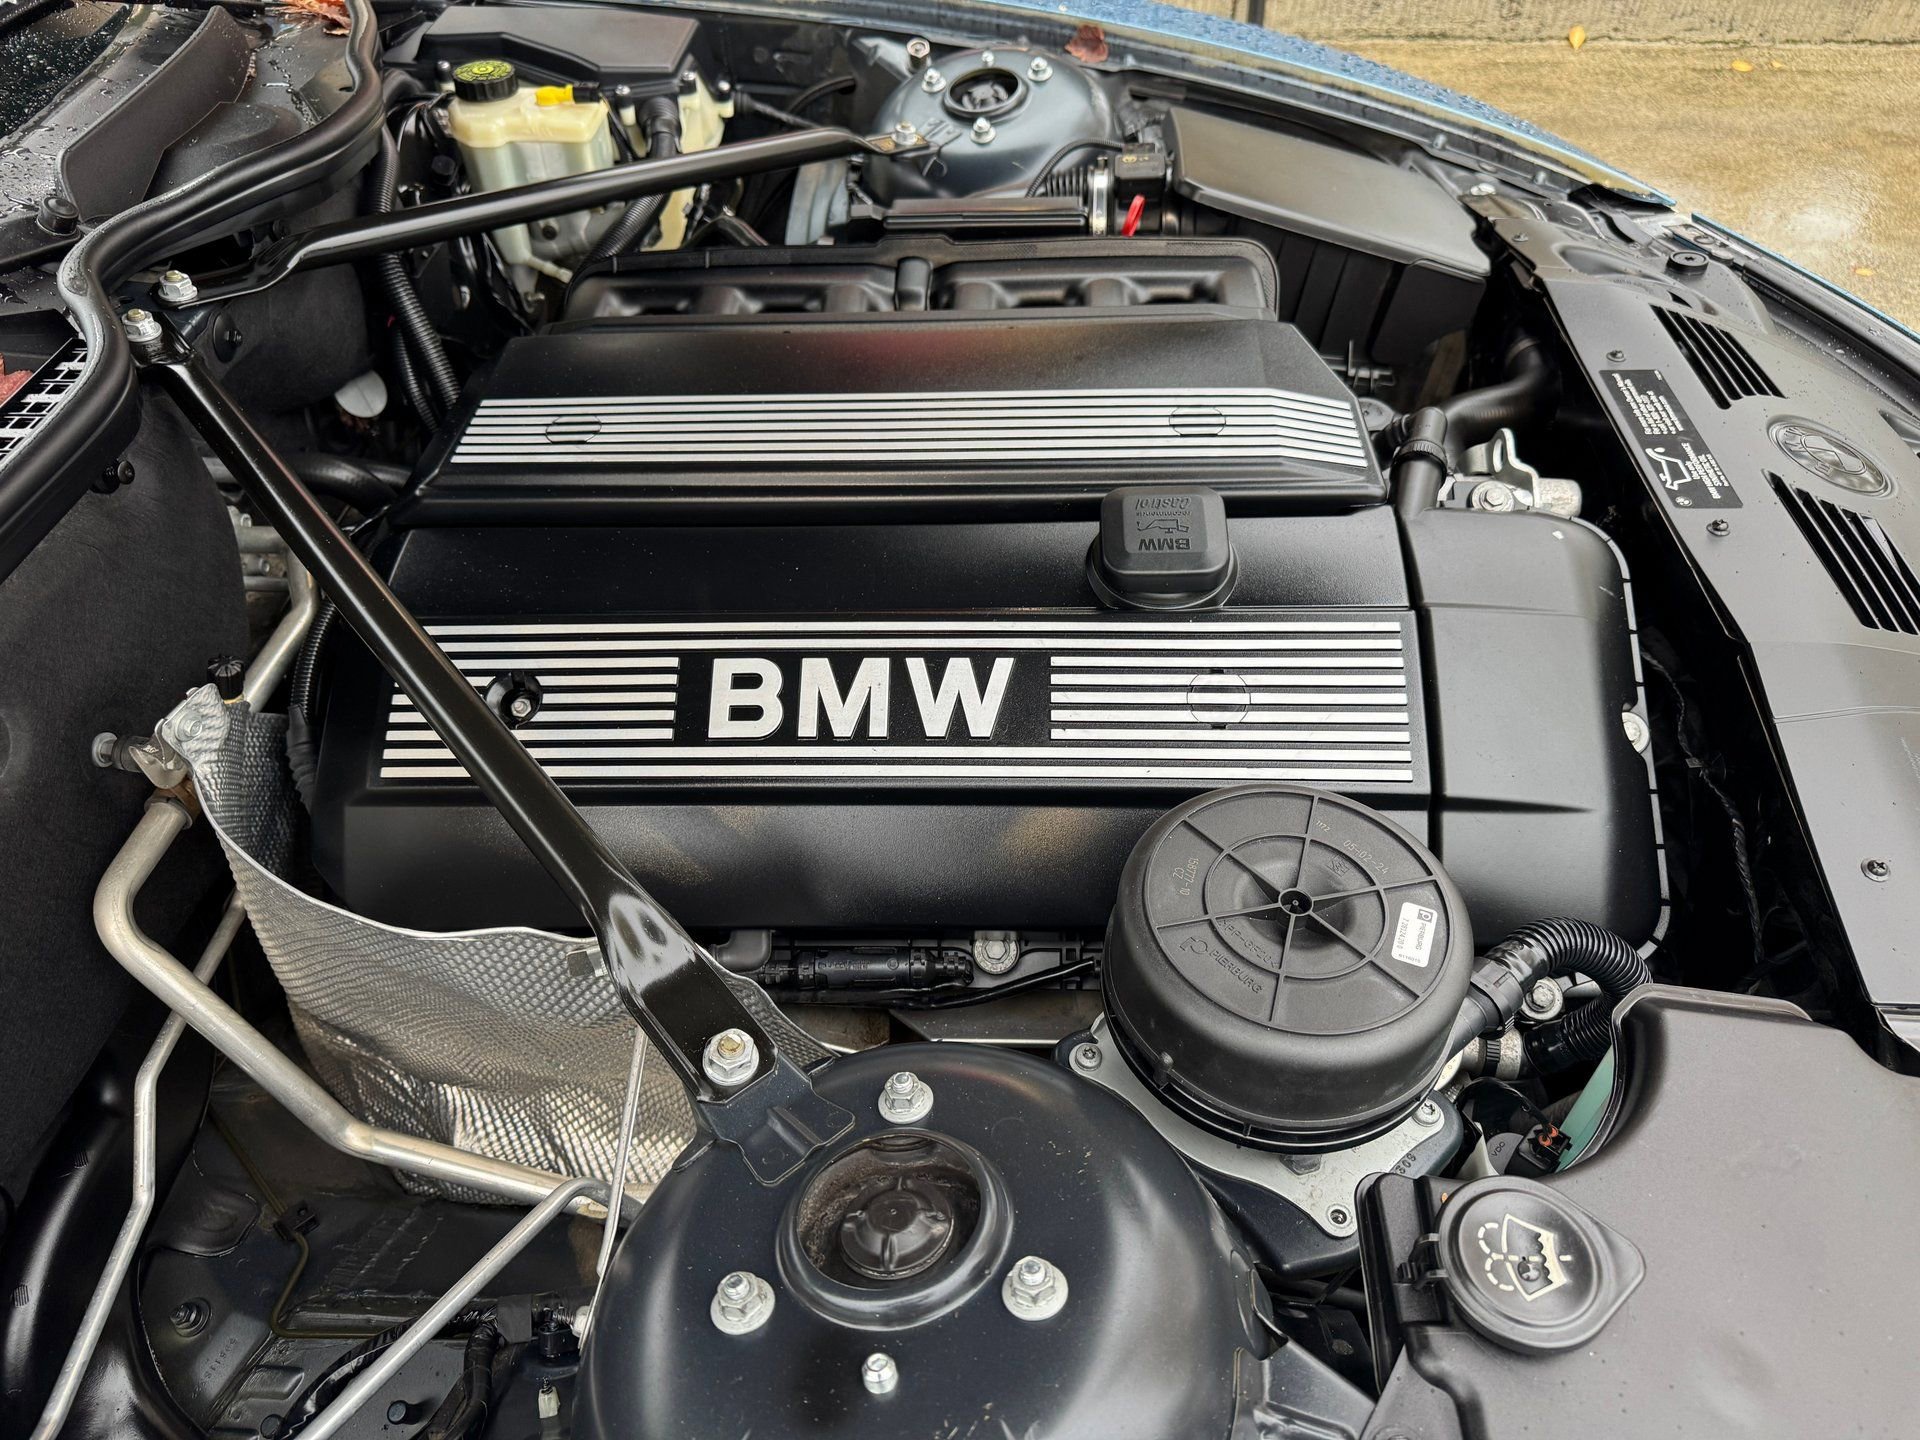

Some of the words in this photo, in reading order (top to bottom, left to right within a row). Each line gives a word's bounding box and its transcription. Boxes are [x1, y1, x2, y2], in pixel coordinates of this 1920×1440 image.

[1138, 538, 1191, 551] BMW
[706, 657, 1016, 741] BMW
[1173, 867, 1184, 880] CZ
[1209, 949, 1263, 994] PIERBURG
[1491, 1141, 1506, 1157] VDO
